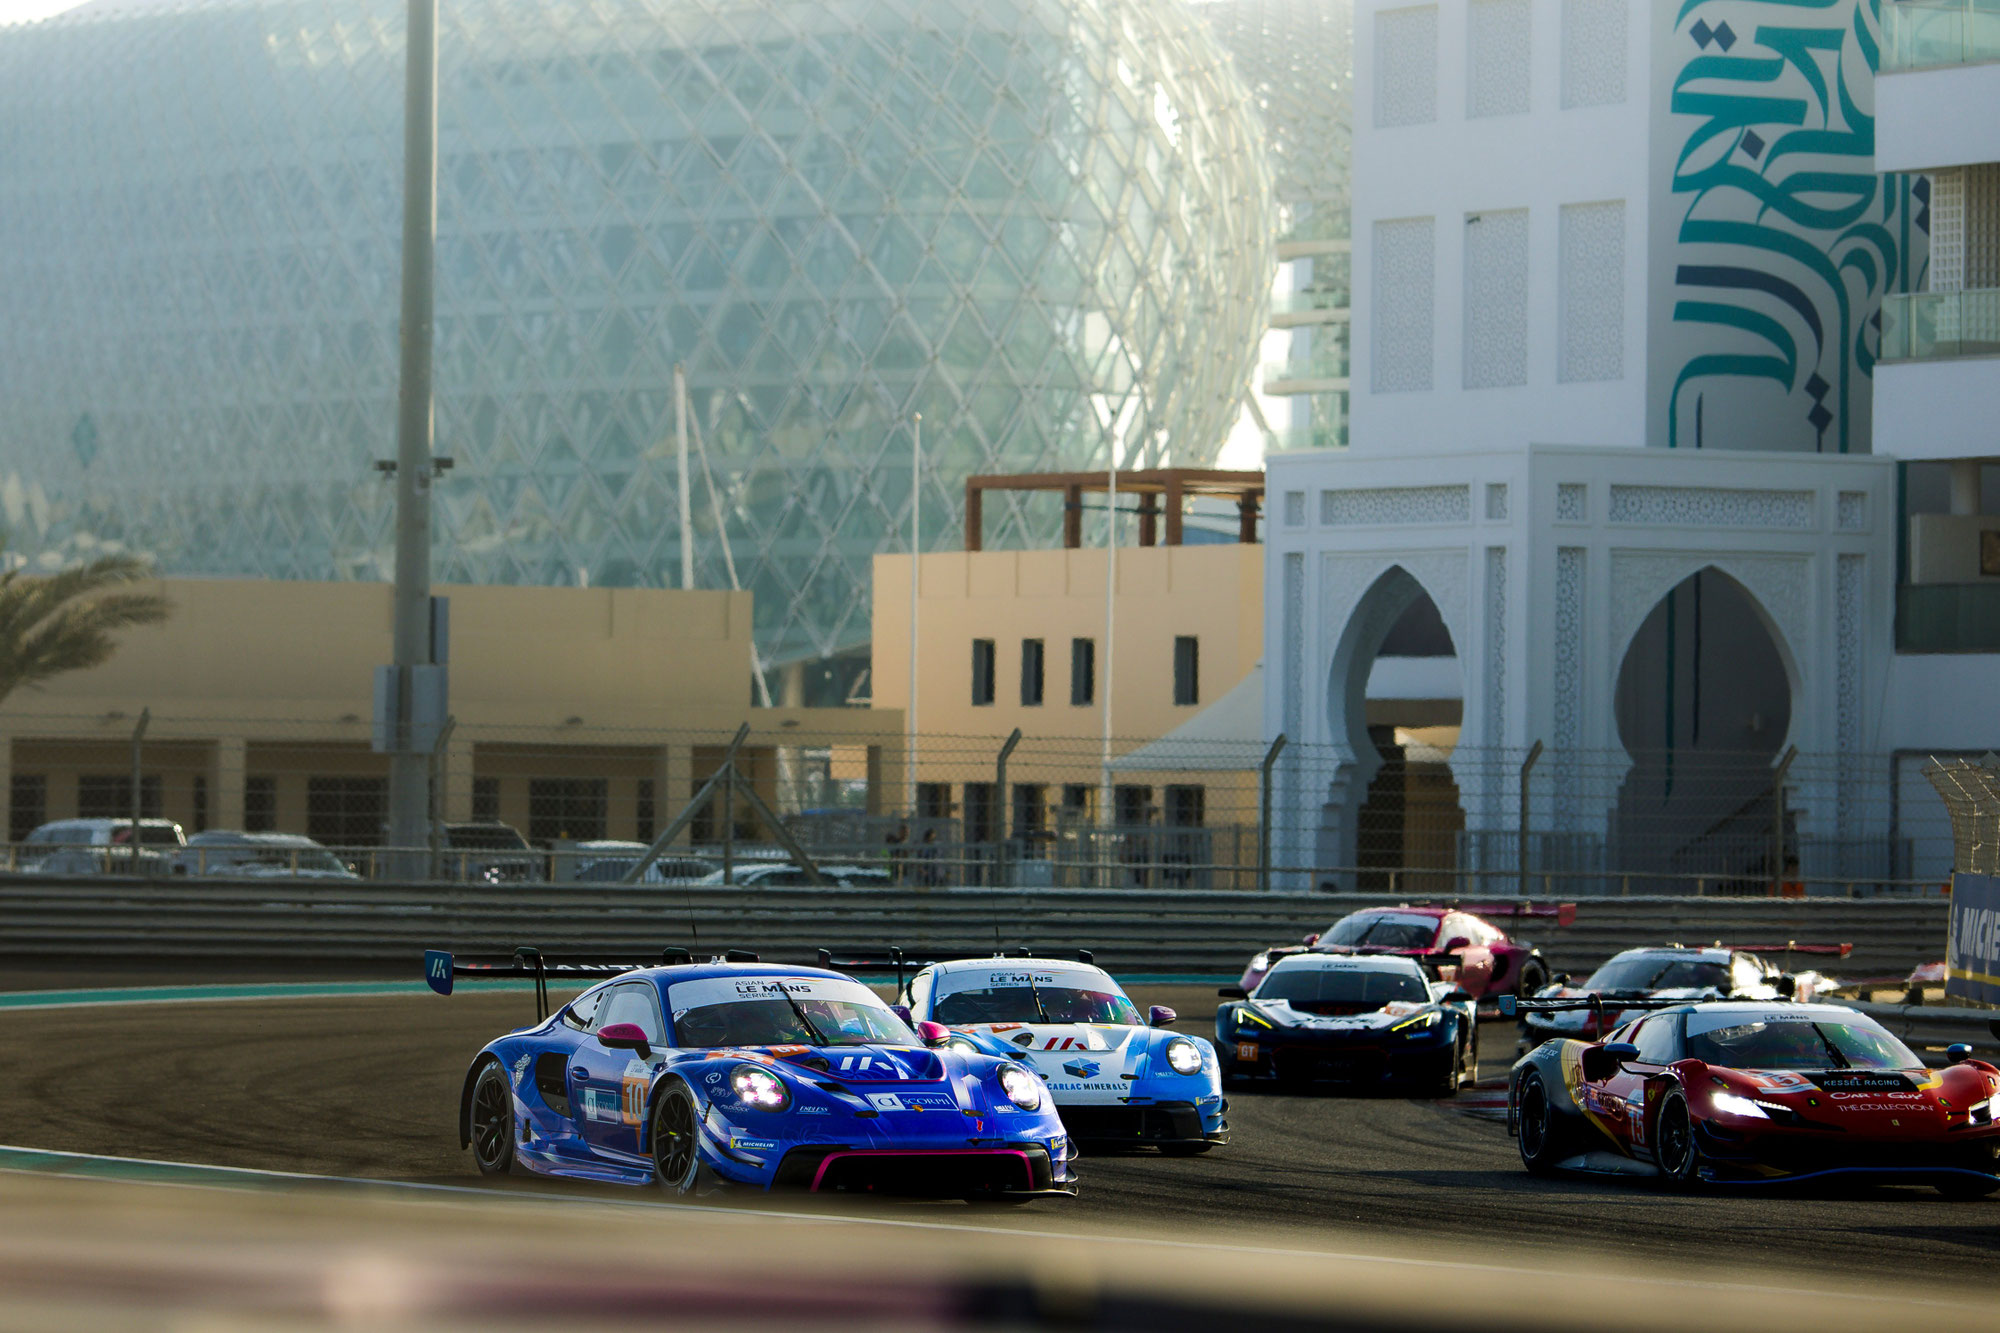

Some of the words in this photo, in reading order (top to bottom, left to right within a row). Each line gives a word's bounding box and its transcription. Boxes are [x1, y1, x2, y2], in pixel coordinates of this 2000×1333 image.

[1241, 1045, 1255, 1058] GT
[1047, 1082, 1082, 1091] CARLAC
[1083, 1082, 1129, 1091] MINERALS
[626, 1081, 645, 1121] 10
